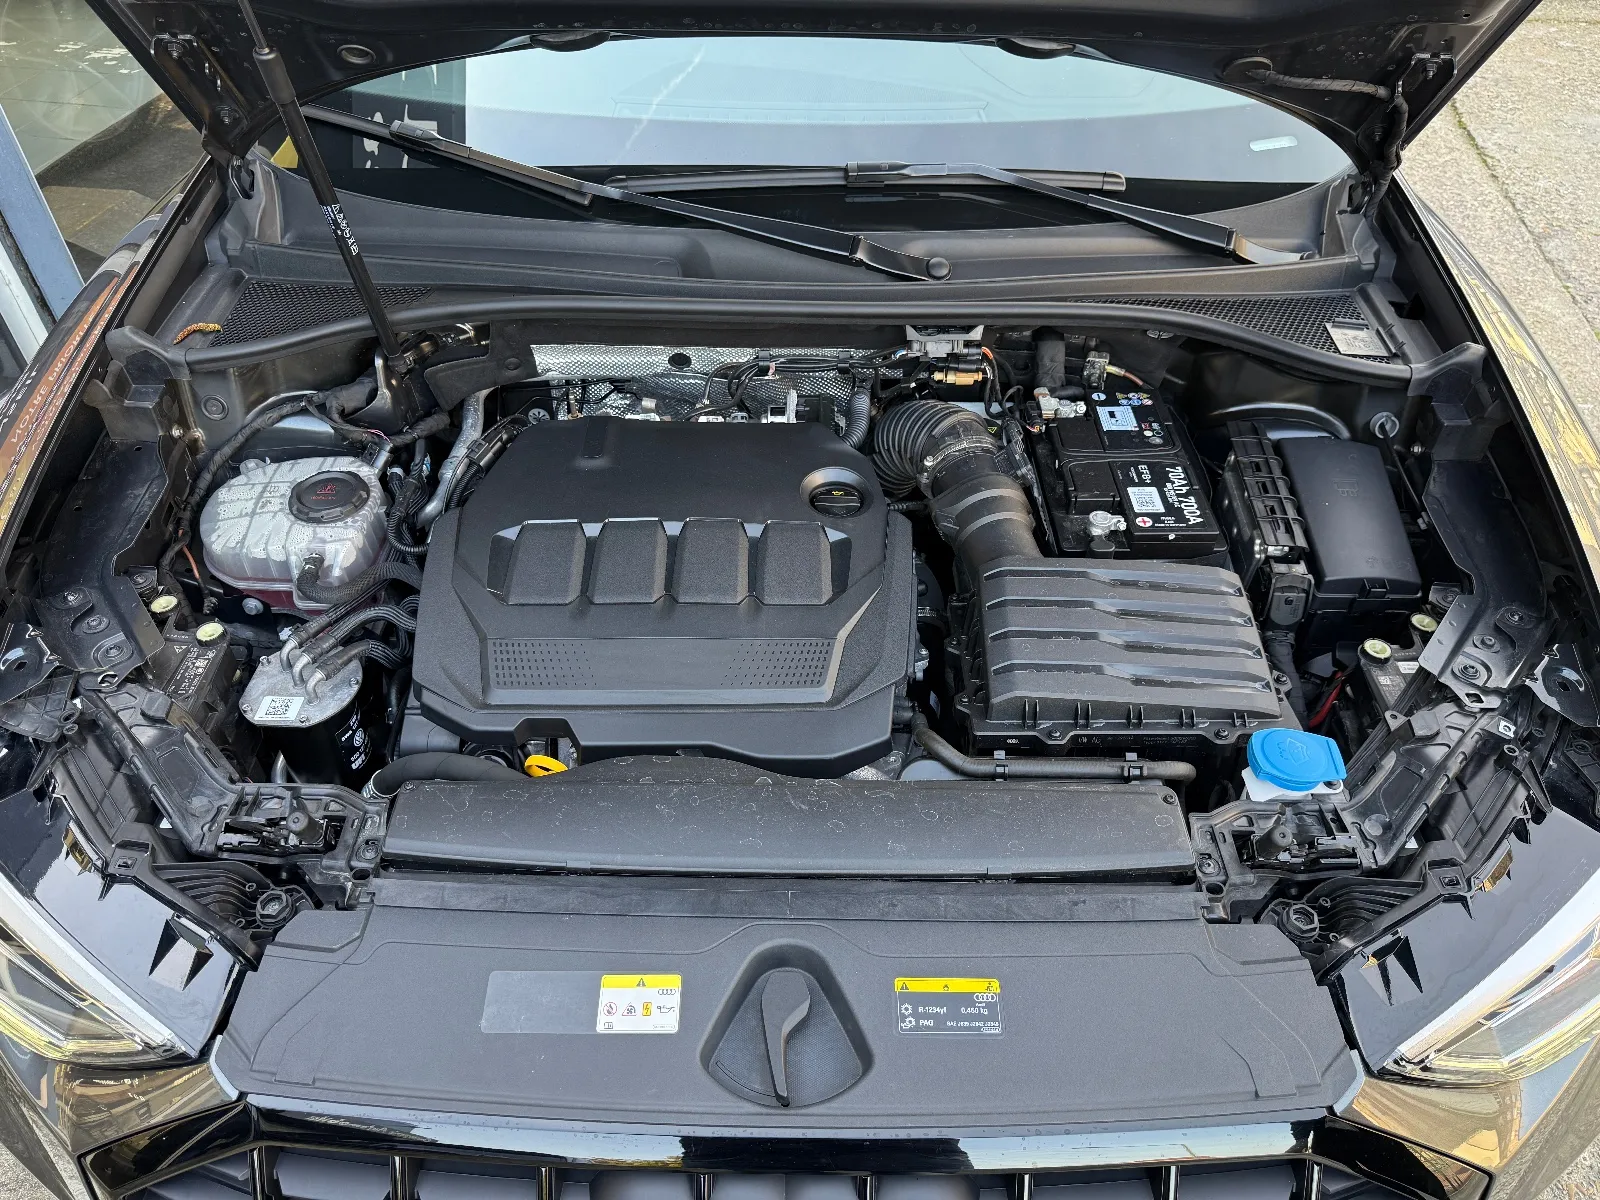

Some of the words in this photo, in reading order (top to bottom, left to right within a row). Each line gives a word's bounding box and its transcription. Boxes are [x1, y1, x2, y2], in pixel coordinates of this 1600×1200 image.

[1165, 466, 1190, 493] 70Ah
[1177, 496, 1204, 524] 700A
[918, 1006, 947, 1015] R-1234yf
